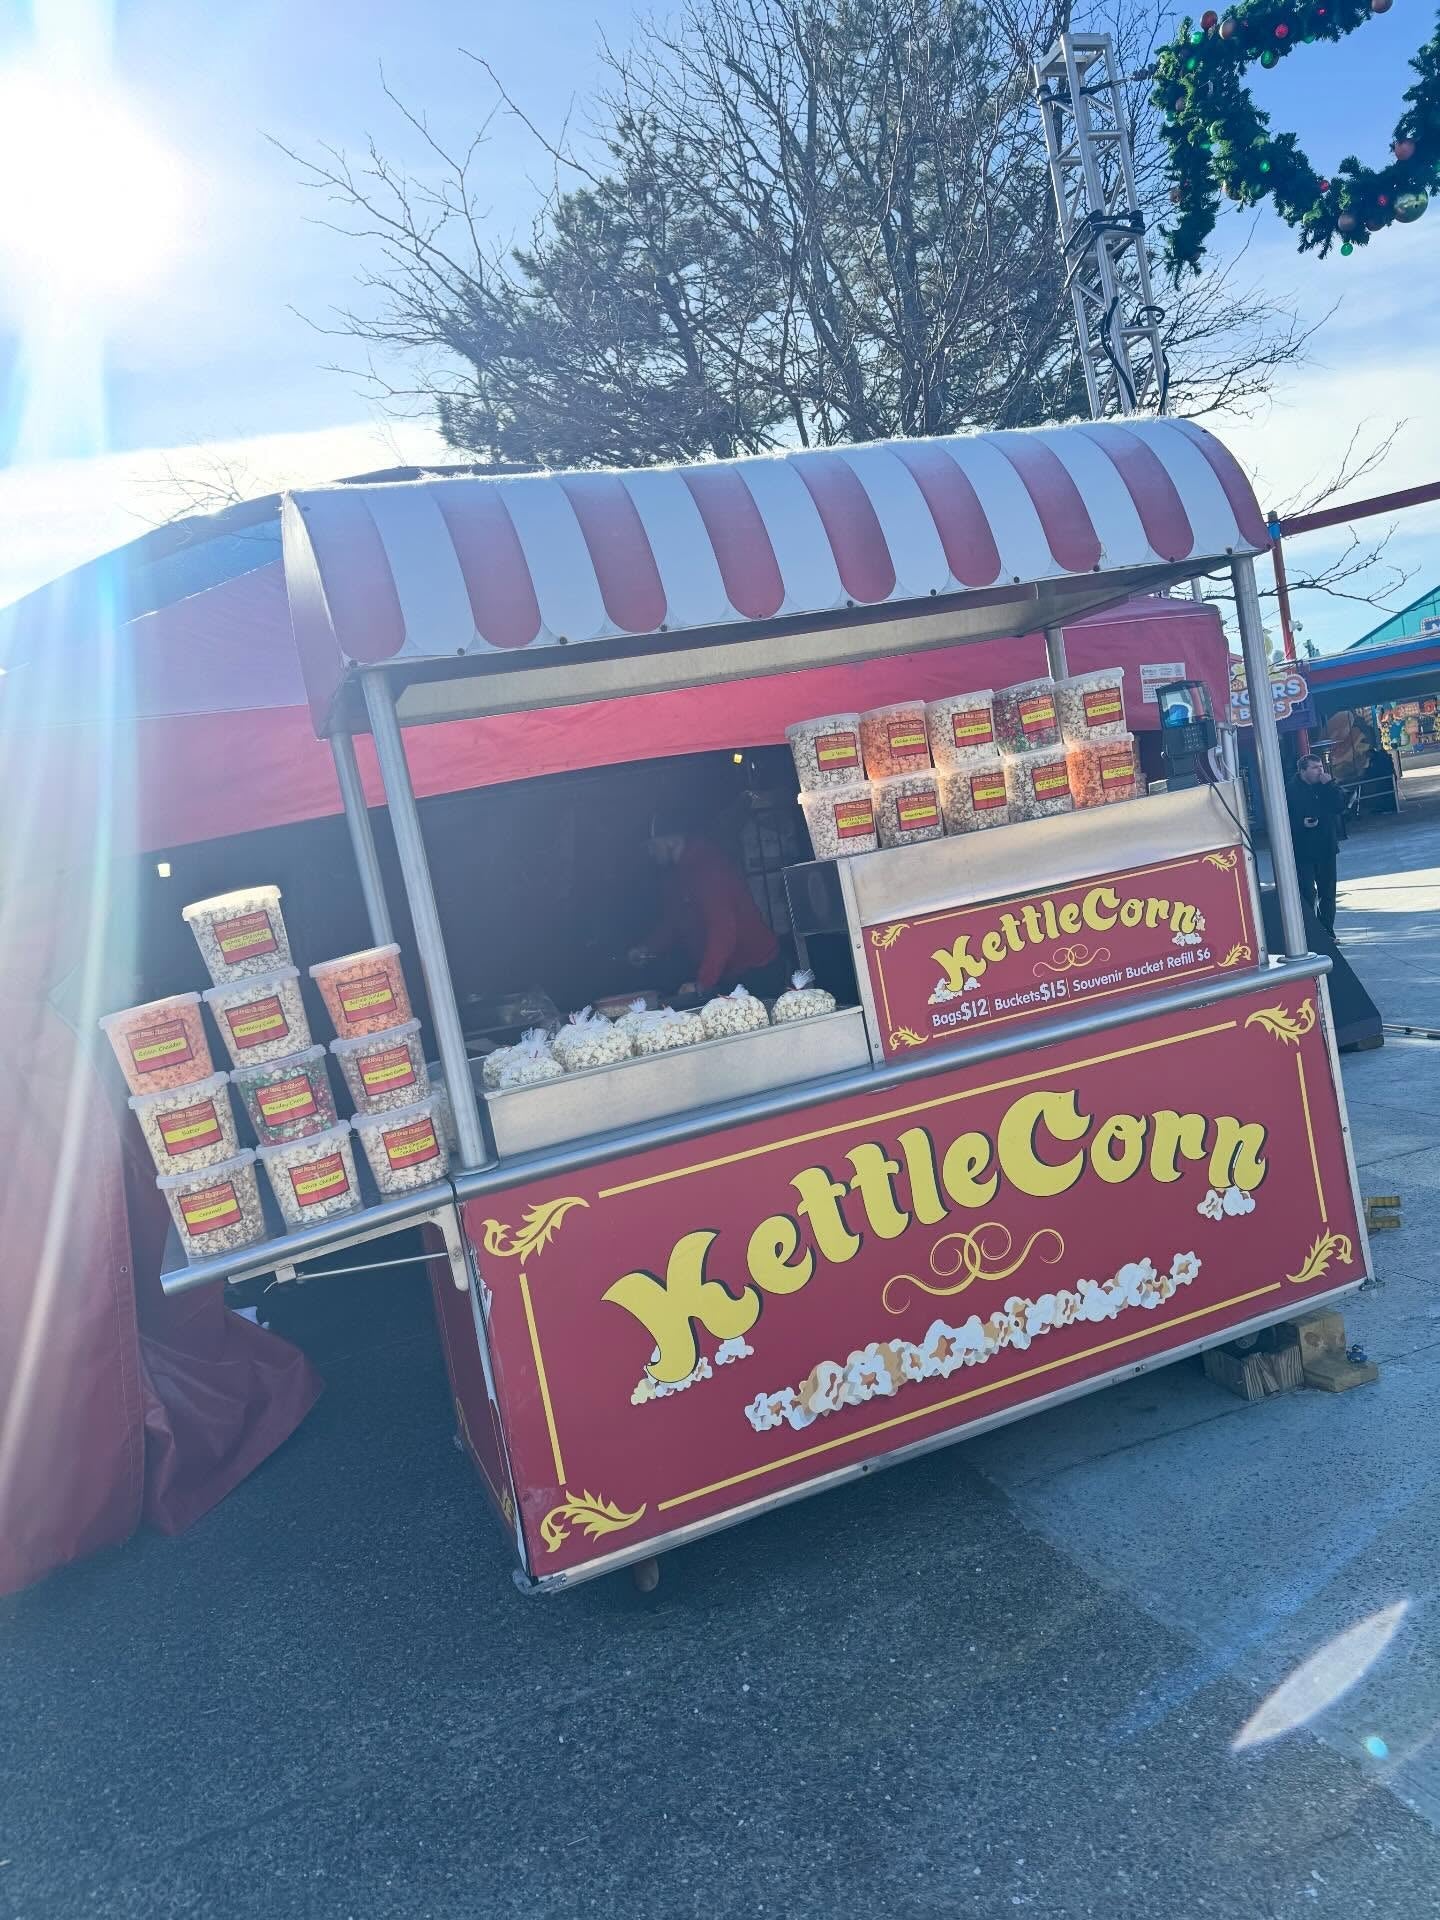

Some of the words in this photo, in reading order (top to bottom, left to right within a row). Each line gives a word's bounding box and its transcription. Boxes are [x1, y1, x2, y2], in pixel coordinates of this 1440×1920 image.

[1072, 971, 1123, 992] Souvenir
[1125, 960, 1165, 980] Bucket
[1167, 950, 1195, 970] Refill
[1197, 949, 1211, 962] $6
